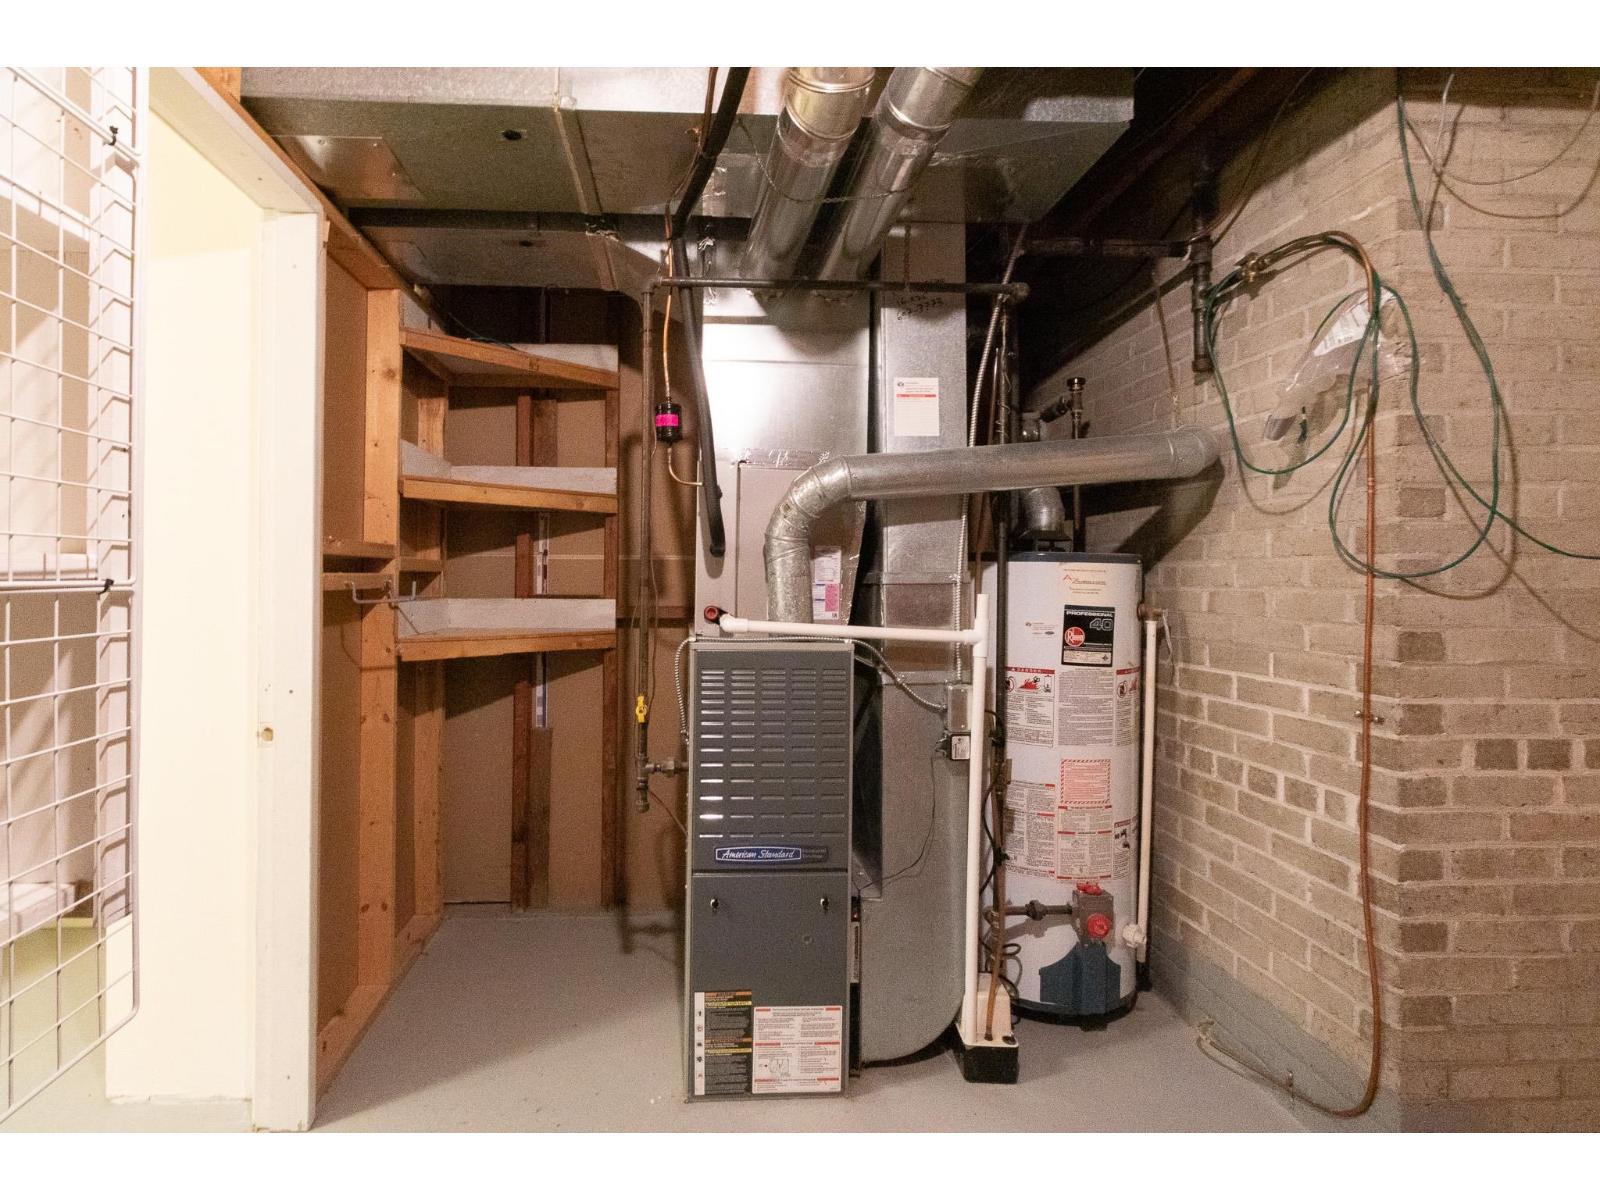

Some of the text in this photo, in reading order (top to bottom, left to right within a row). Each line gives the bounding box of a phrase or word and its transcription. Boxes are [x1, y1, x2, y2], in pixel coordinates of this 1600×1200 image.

[1089, 617, 1113, 631] 40
[722, 848, 795, 860] American Standard
